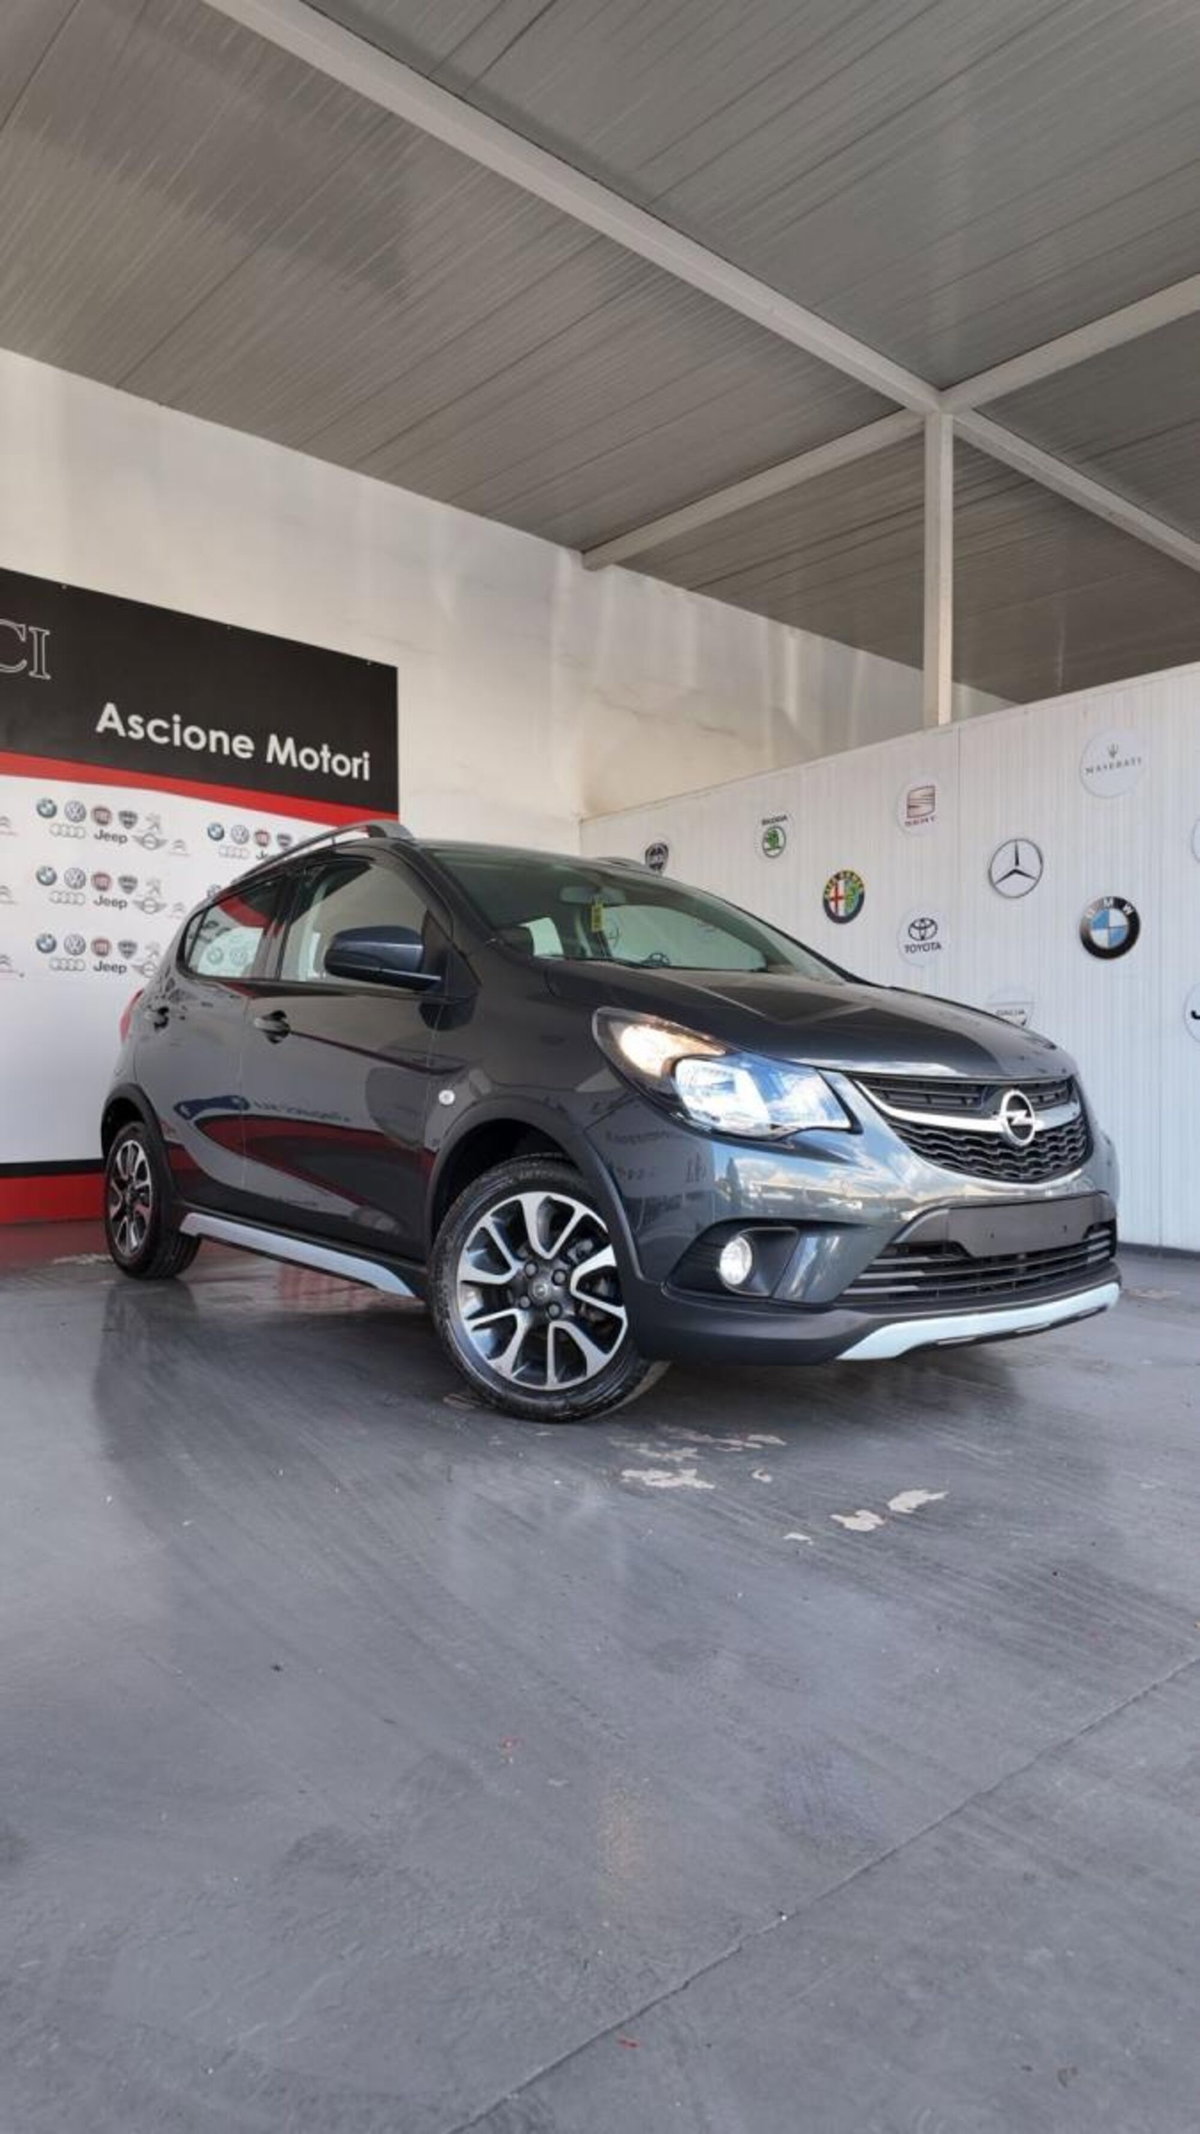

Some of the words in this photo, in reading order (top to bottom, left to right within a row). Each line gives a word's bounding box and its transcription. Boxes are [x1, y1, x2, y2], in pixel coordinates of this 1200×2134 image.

[95, 702, 255, 759] Ascione
[265, 734, 371, 781] Motori
[1085, 757, 1142, 775] MASERATI
[94, 829, 128, 846] Jeep
[93, 895, 128, 910] Jeep
[1086, 896, 1134, 920] BMW
[904, 941, 942, 954] TOYOTA
[93, 961, 127, 974] Jeep
